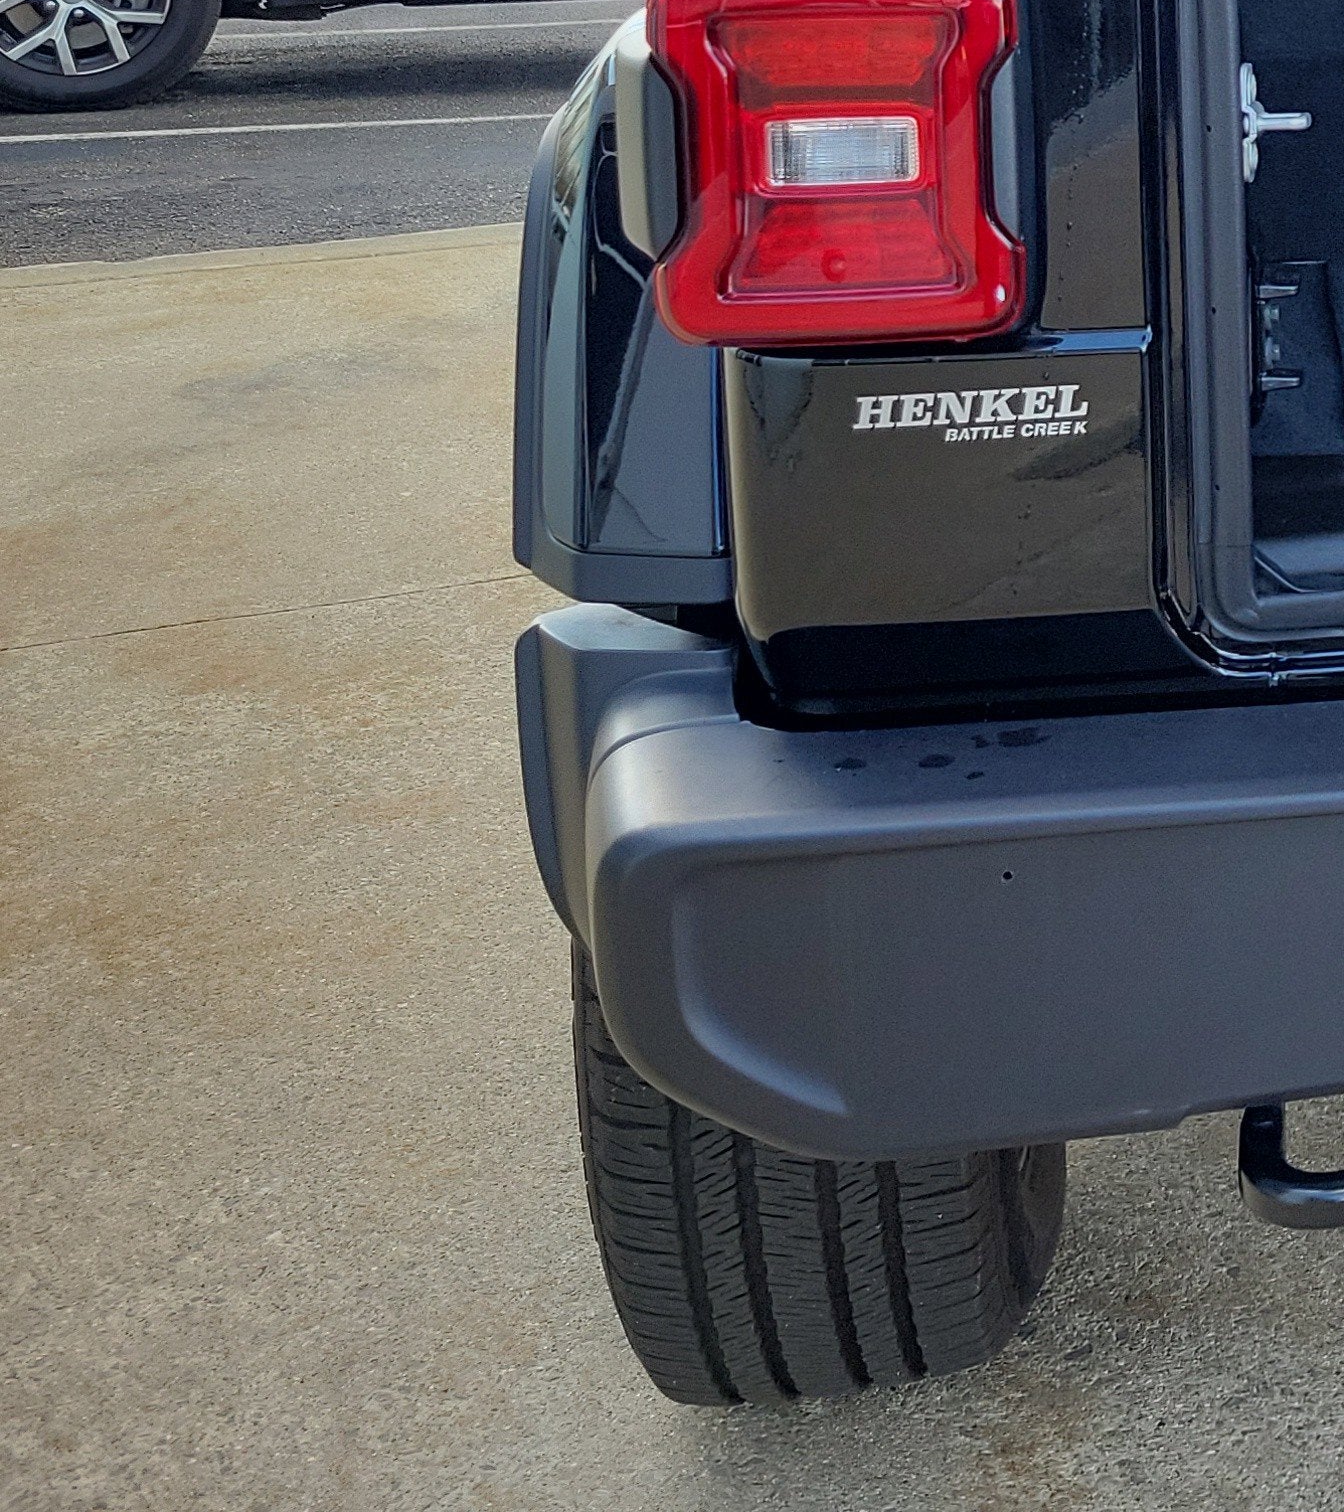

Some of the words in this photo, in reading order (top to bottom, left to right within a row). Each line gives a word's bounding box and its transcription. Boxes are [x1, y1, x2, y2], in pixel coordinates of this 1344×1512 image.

[853, 384, 1090, 430] HENKEL
[945, 424, 1016, 442] BATTLE
[1021, 420, 1089, 438] CREEK
